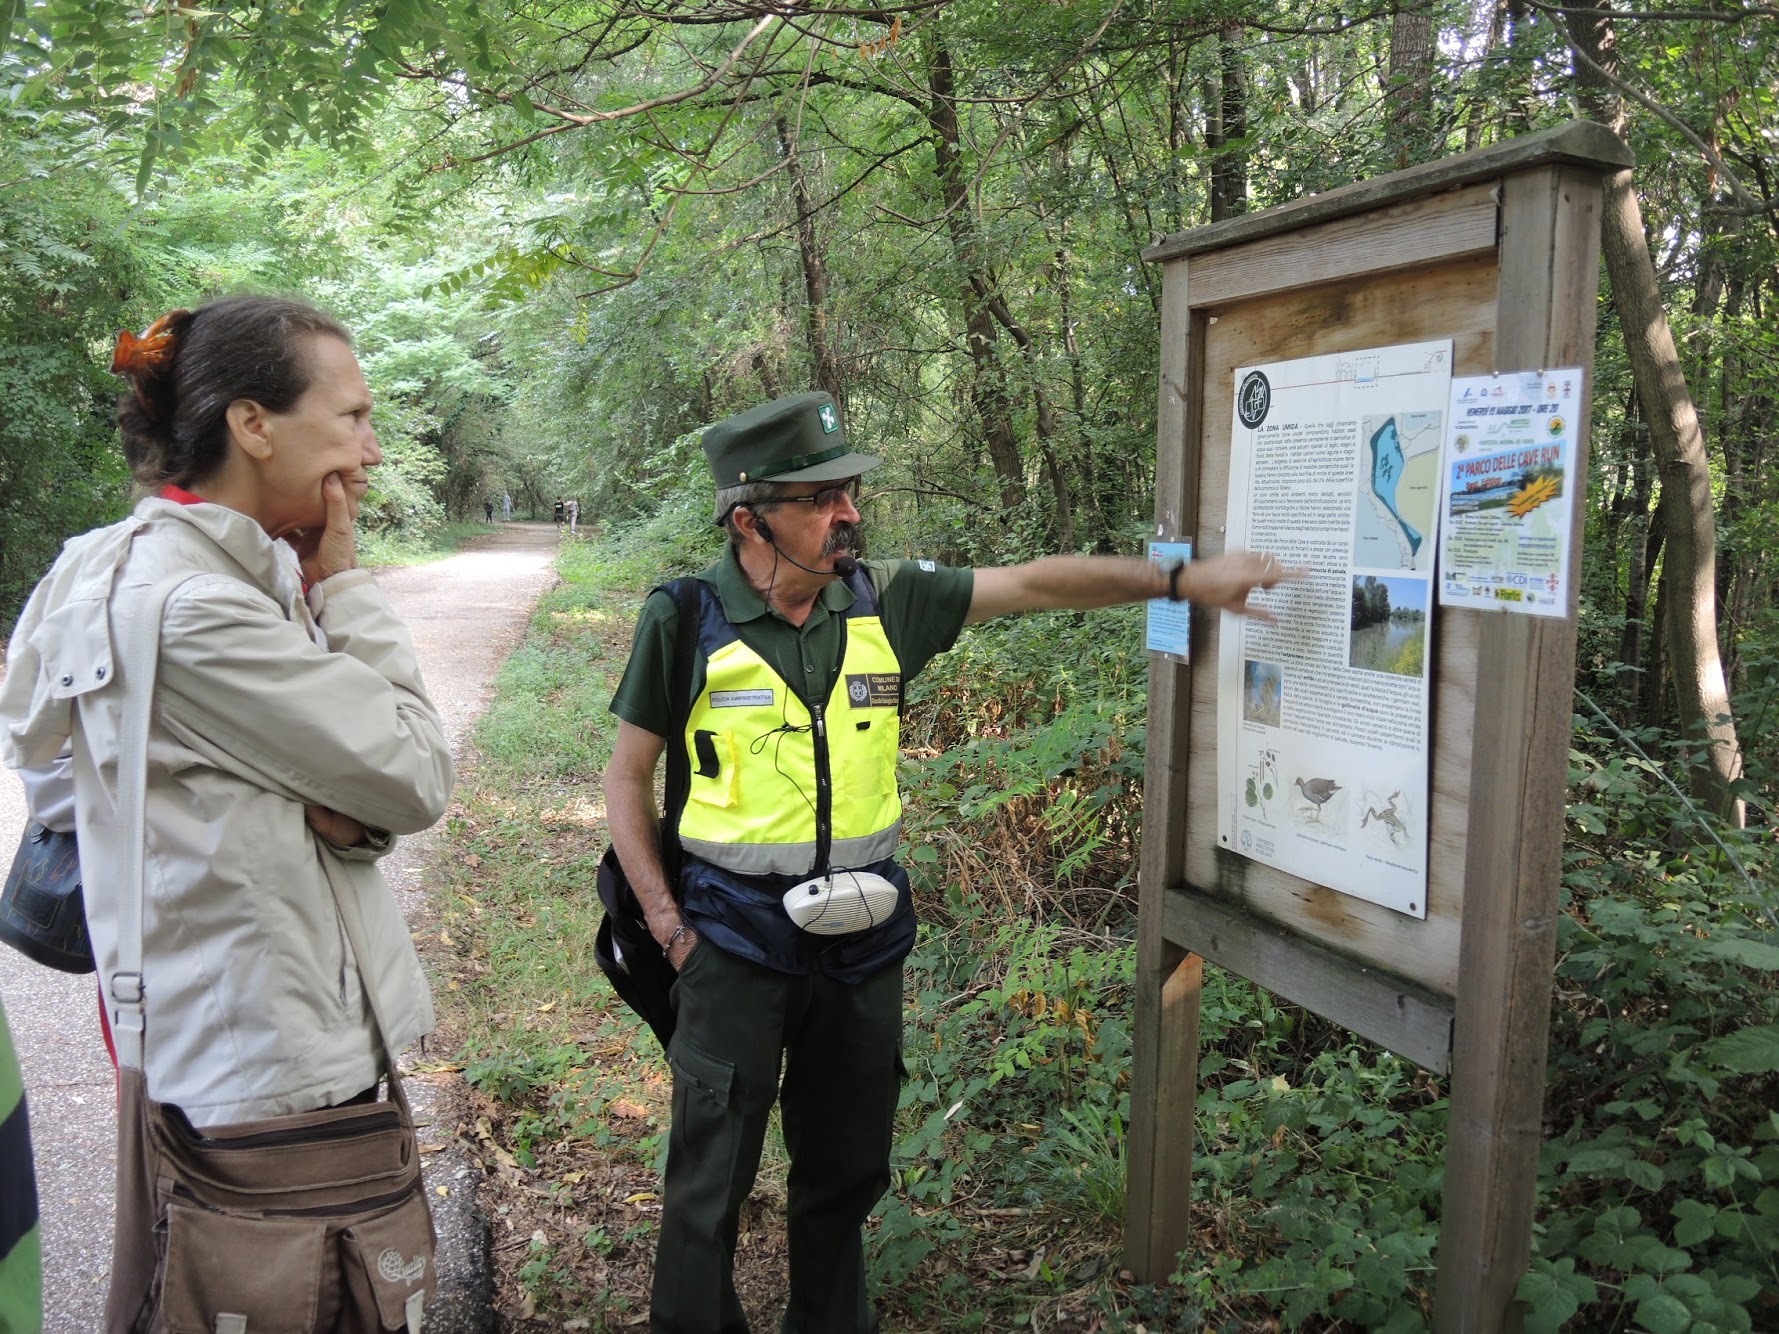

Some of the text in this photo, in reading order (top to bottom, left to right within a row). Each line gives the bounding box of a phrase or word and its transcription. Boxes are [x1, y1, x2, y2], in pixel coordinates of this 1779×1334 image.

[1465, 458, 1492, 478] PARCO
[1493, 453, 1516, 472] DELLE
[1518, 448, 1539, 468] CAVE
[1541, 444, 1560, 464] RUN
